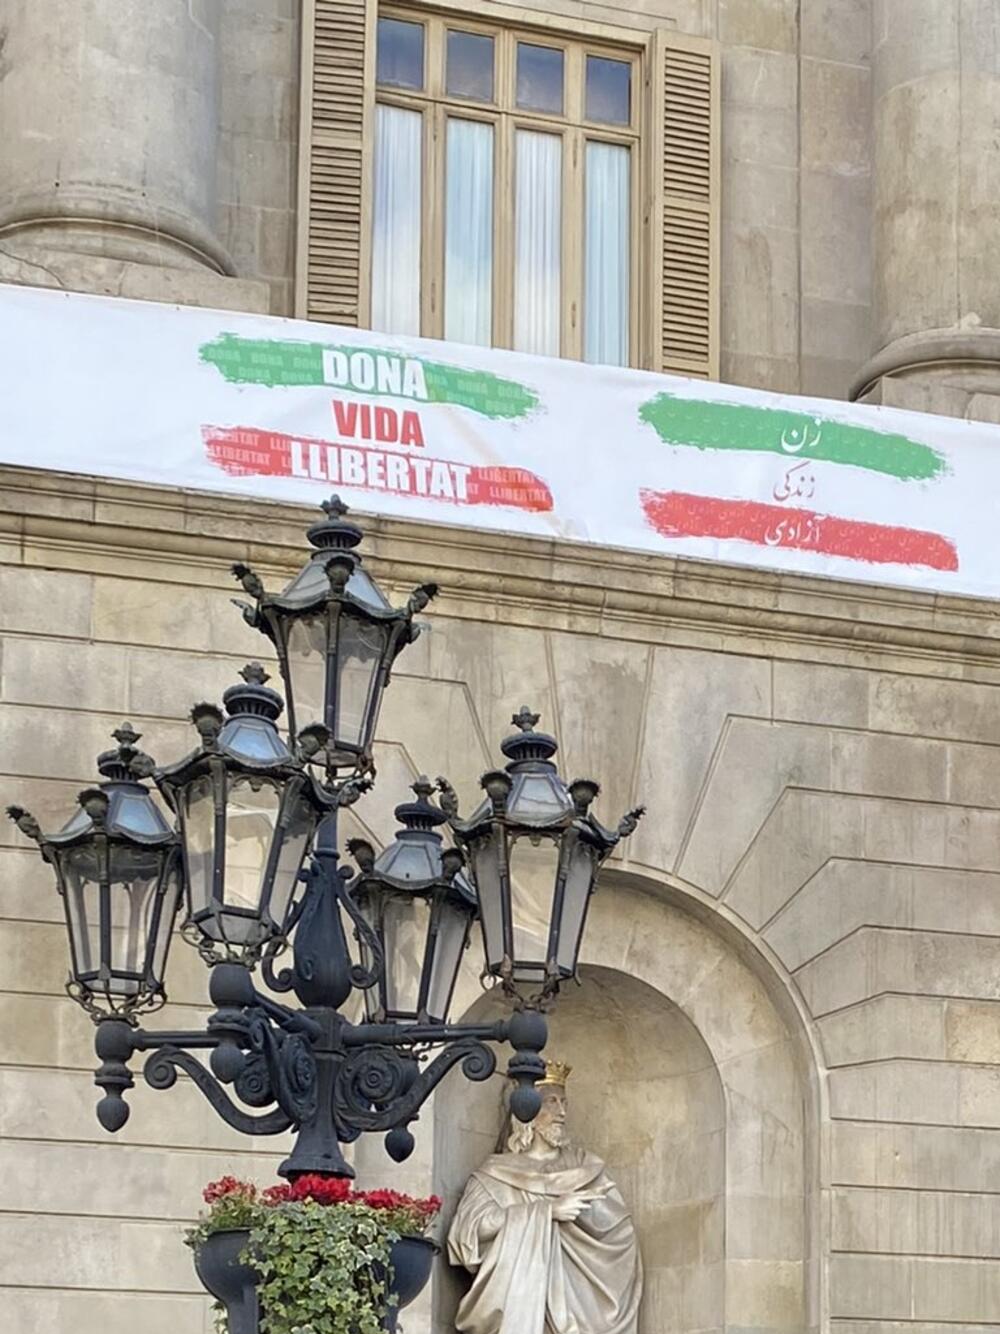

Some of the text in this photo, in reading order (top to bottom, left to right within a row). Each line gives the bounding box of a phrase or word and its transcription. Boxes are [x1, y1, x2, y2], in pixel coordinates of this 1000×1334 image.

[322, 349, 428, 400] DONA
[332, 399, 425, 448] VIDA
[781, 418, 821, 453] زن
[291, 440, 471, 500] LLIBERTAT
[764, 514, 828, 546] آزادی
